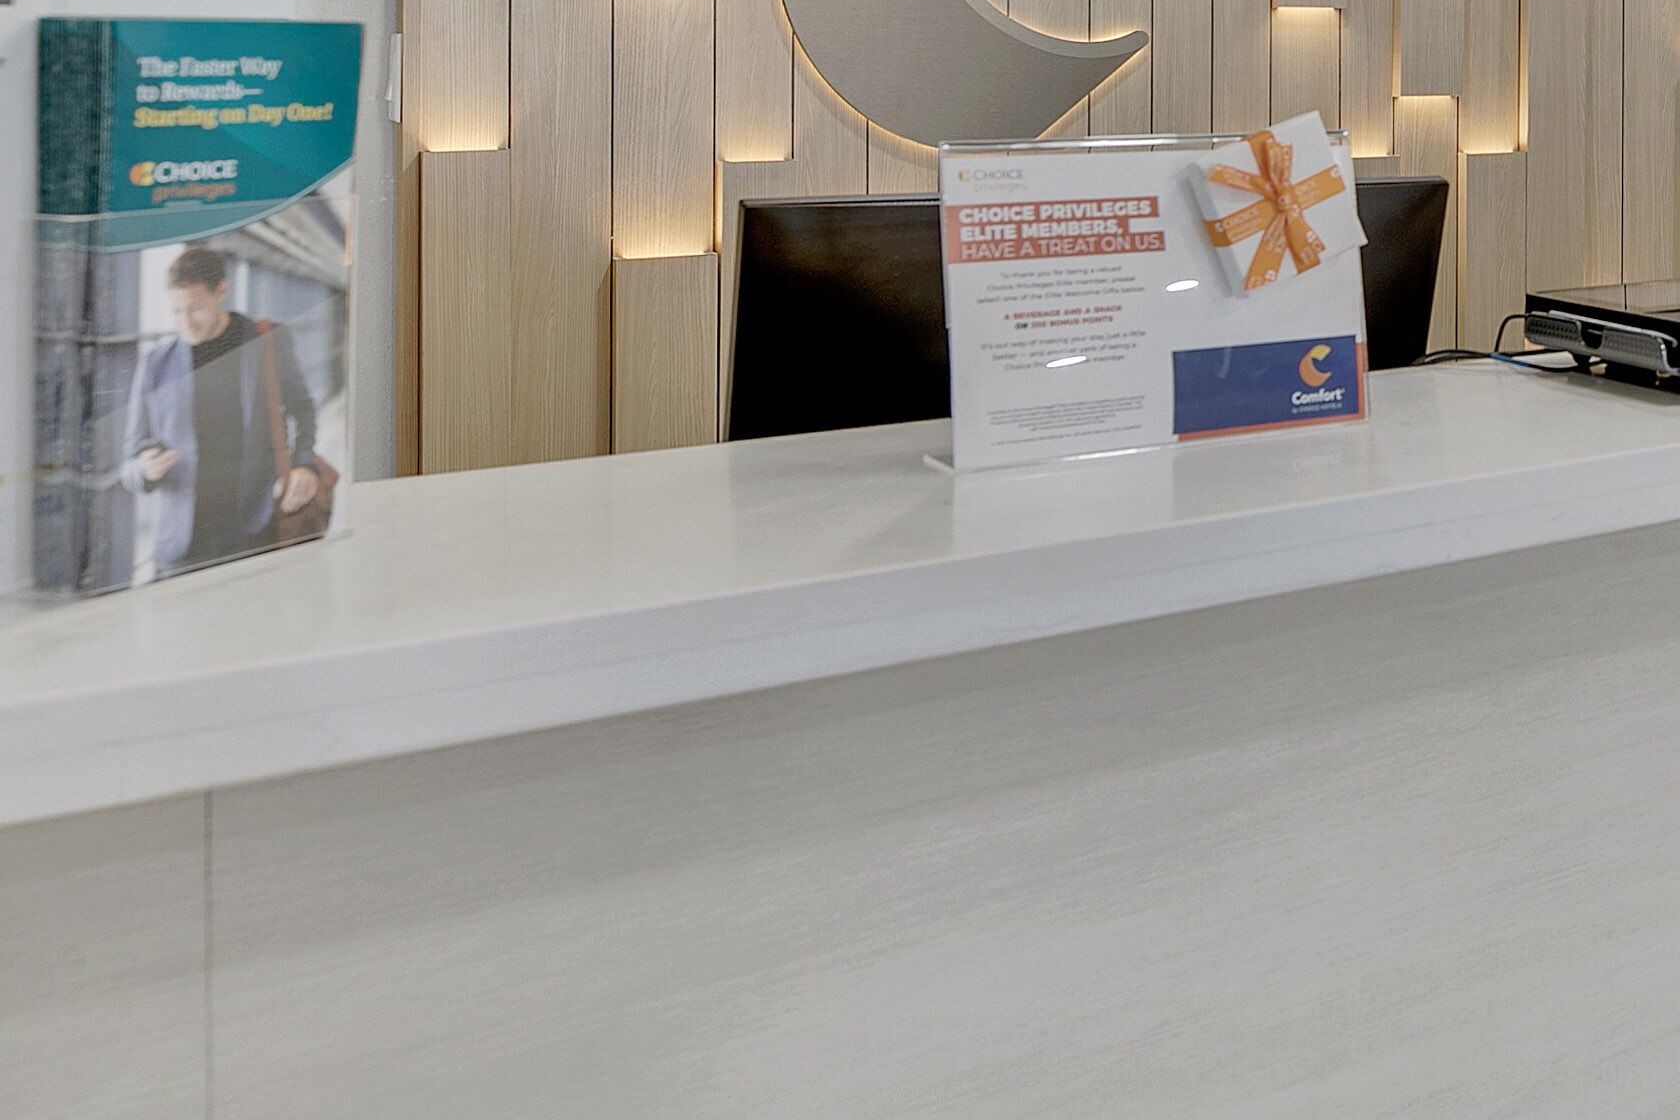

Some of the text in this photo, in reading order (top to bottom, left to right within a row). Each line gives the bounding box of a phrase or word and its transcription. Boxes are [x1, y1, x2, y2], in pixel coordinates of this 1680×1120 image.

[137, 56, 283, 81] The Faster Way
[136, 84, 161, 103] to
[134, 102, 334, 129] Starting on Day One!
[154, 159, 239, 184] CHOICE
[972, 169, 1024, 181] CHOICE
[959, 199, 1152, 224] CHOICE PRIVILEGES
[960, 219, 1124, 242] ELITE MEMBERS,
[961, 232, 1164, 260] HAVE A TREAT ON US.
[1291, 388, 1343, 406] Comfort
